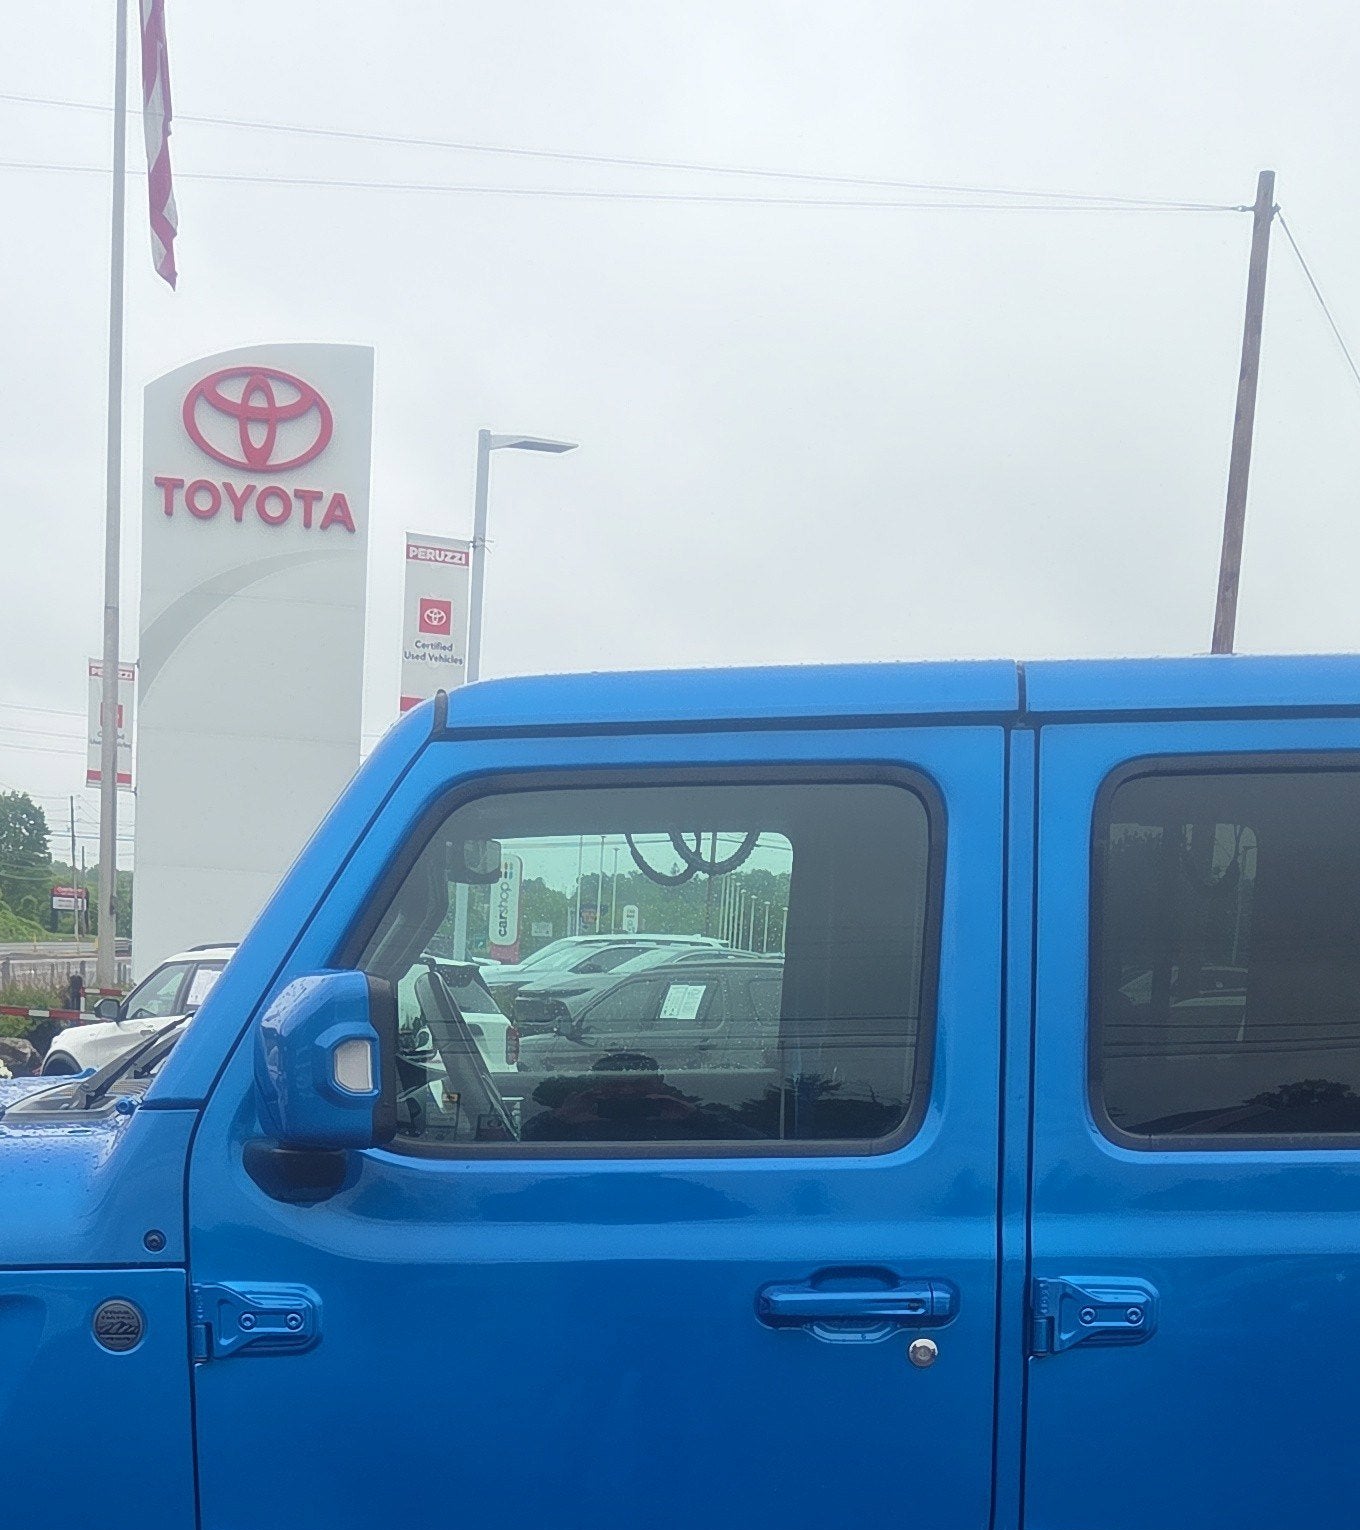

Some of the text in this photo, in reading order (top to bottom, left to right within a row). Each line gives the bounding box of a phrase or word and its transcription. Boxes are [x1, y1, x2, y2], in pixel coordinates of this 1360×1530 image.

[154, 476, 356, 533] TOYOTA
[408, 546, 466, 565] PERUZZI
[414, 639, 454, 652] Certified
[404, 650, 463, 665] Used Vehicles
